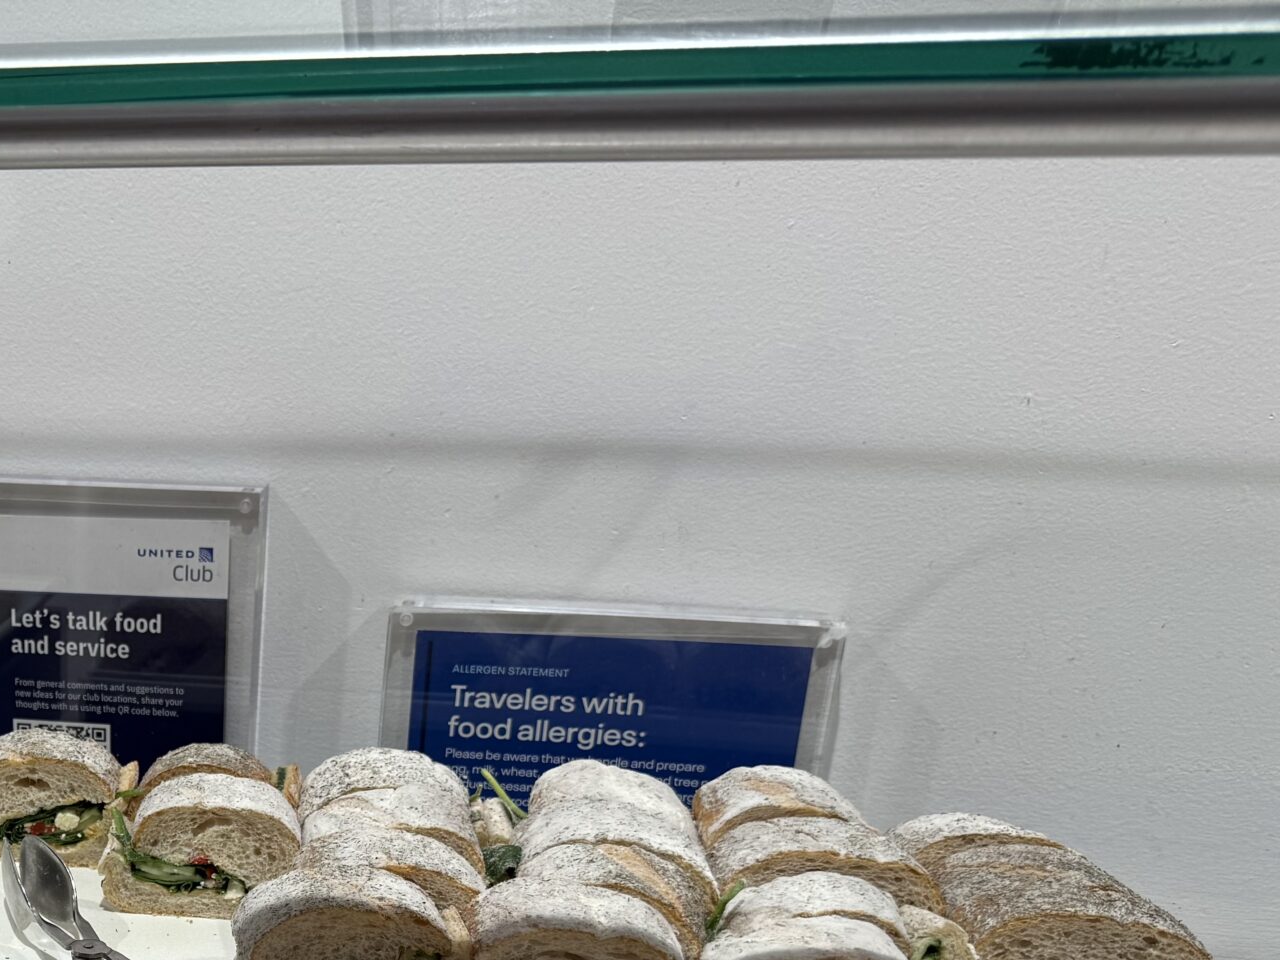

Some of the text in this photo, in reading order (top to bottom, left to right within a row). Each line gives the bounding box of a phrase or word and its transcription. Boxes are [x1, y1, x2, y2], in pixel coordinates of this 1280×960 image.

[137, 548, 195, 559] UNITED
[172, 564, 214, 583] Club
[10, 608, 162, 634] Let’s talk food
[11, 635, 130, 660] and service
[452, 664, 569, 678] ALLERGEN STATEMENT
[14, 678, 184, 695] From general comments and suggestions to
[15, 690, 31, 698] new
[32, 690, 54, 699] ideas
[55, 691, 65, 699] for
[82, 693, 99, 702] club
[101, 694, 139, 704] locations,
[141, 697, 163, 706] share
[165, 699, 183, 708] your
[451, 685, 644, 716] Travelers with
[15, 700, 49, 711] thoughts
[80, 704, 102, 714] using
[103, 705, 117, 713] the
[118, 706, 129, 715] QR
[131, 707, 150, 715] code
[152, 708, 179, 717] below.
[448, 715, 647, 750] food allergies:
[445, 747, 484, 759] Please
[485, 750, 500, 760] be
[502, 753, 538, 763] aware
[541, 754, 566, 765] that
[631, 759, 654, 769] and
[656, 761, 705, 773] prepare
[674, 777, 699, 787] tree
